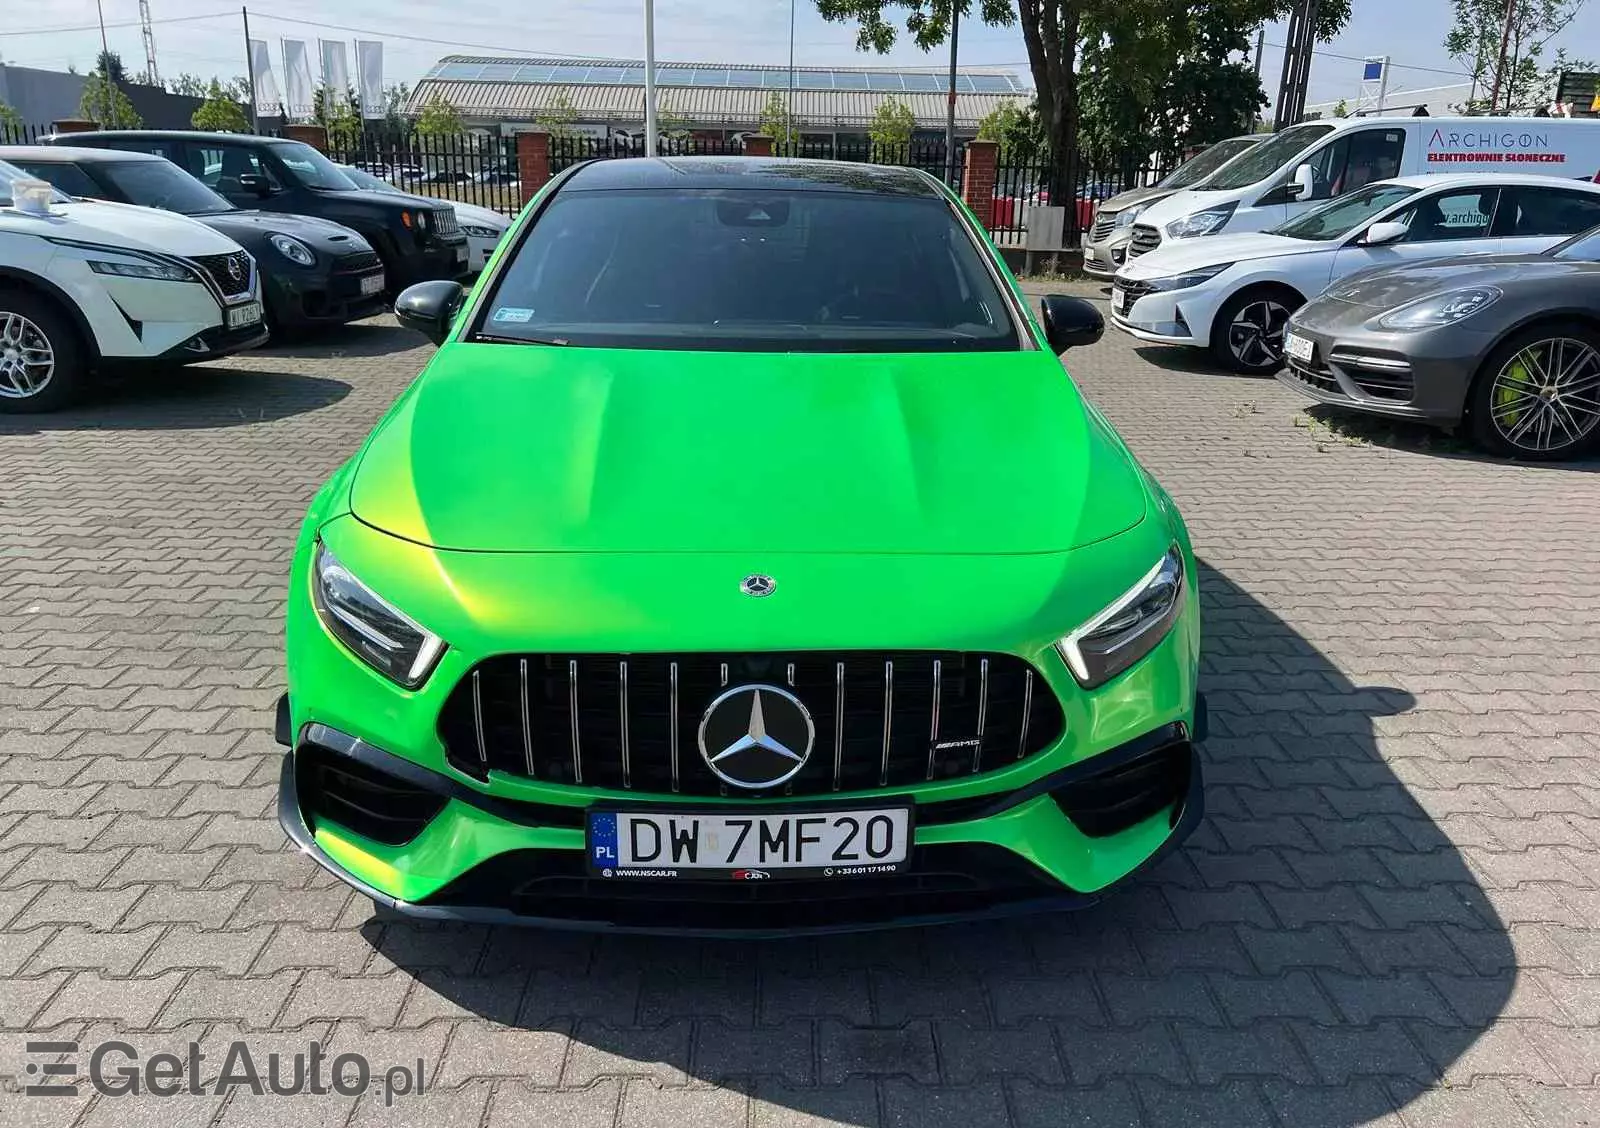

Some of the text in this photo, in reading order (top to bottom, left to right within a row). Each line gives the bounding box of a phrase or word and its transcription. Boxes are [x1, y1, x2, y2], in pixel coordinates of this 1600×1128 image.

[1428, 128, 1549, 148] ARCHIGON
[630, 815, 894, 863] DW 7MF20
[595, 846, 615, 859] PL
